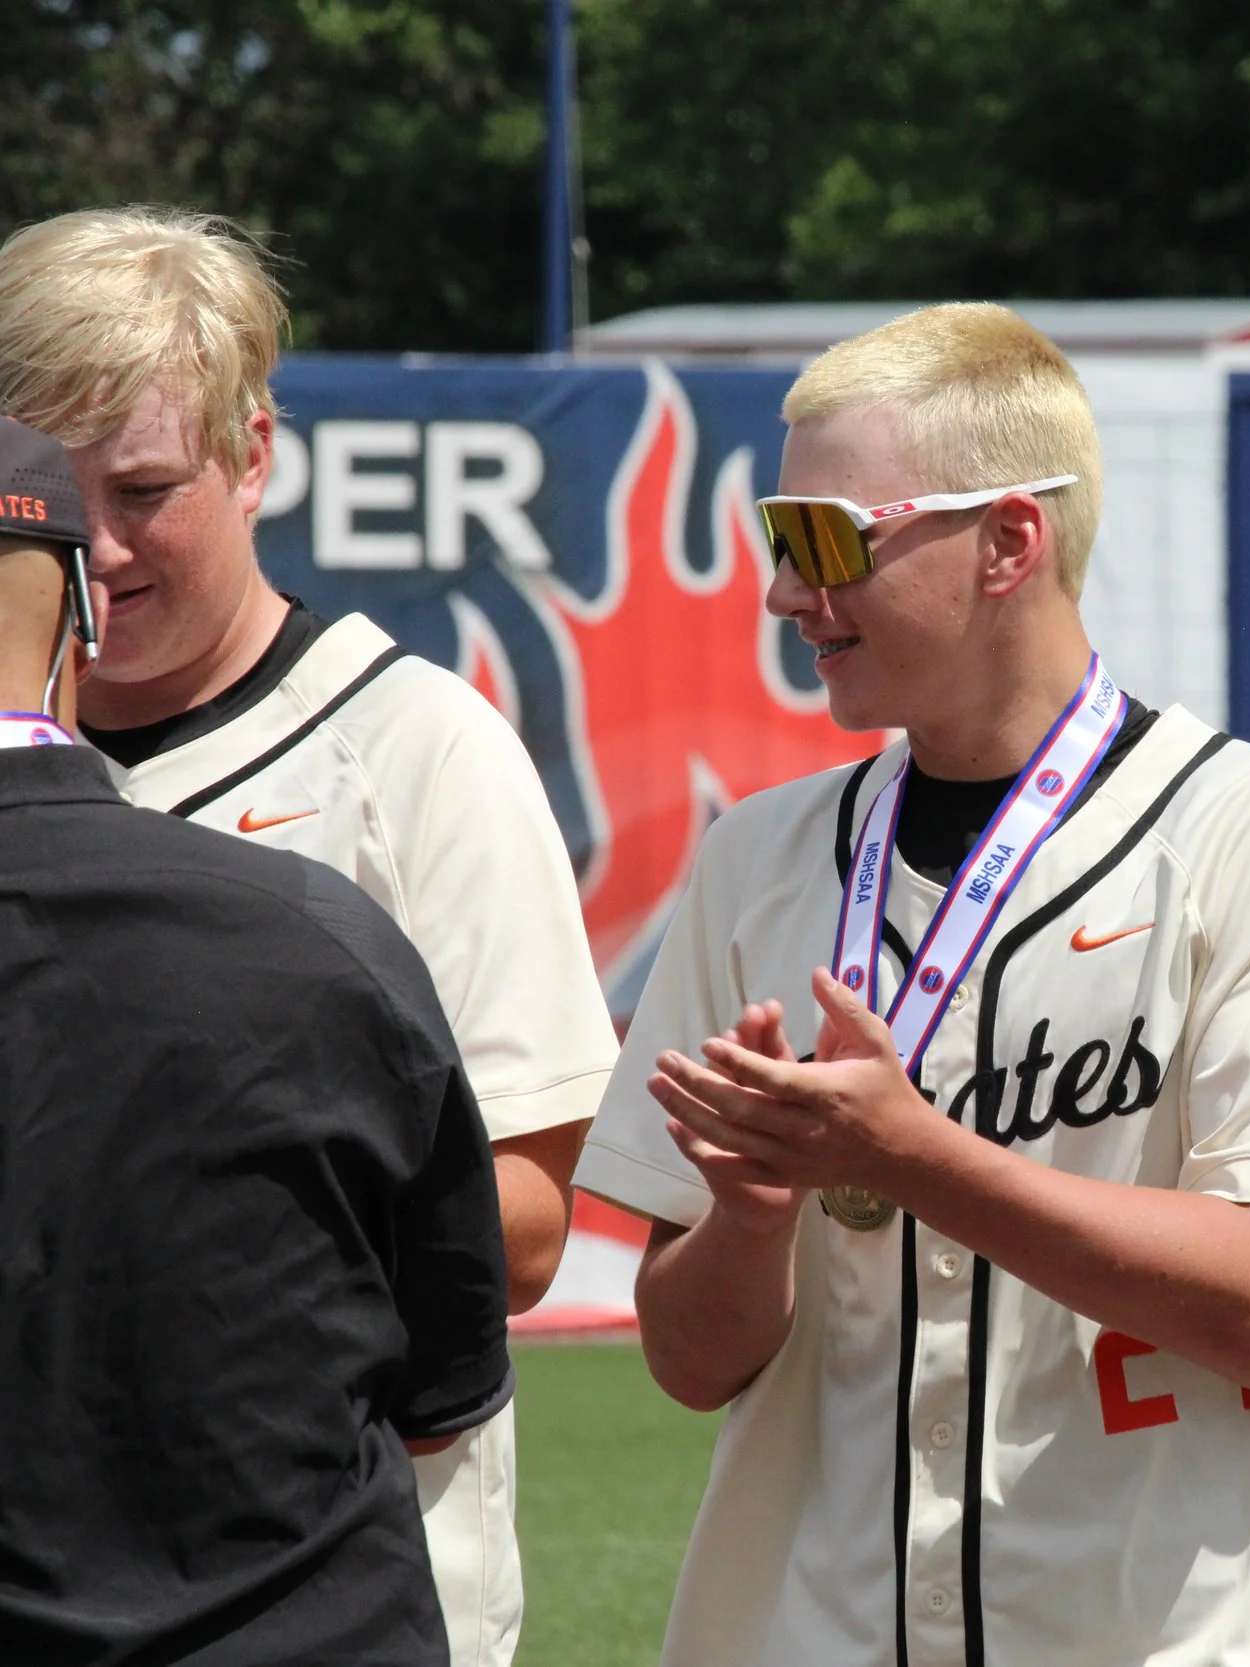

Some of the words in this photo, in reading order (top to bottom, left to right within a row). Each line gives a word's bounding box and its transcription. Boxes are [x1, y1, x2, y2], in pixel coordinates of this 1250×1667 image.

[855, 841, 880, 905] MSHSAA
[966, 844, 1016, 904] MSHSAA
[920, 1015, 1172, 1148] ates
